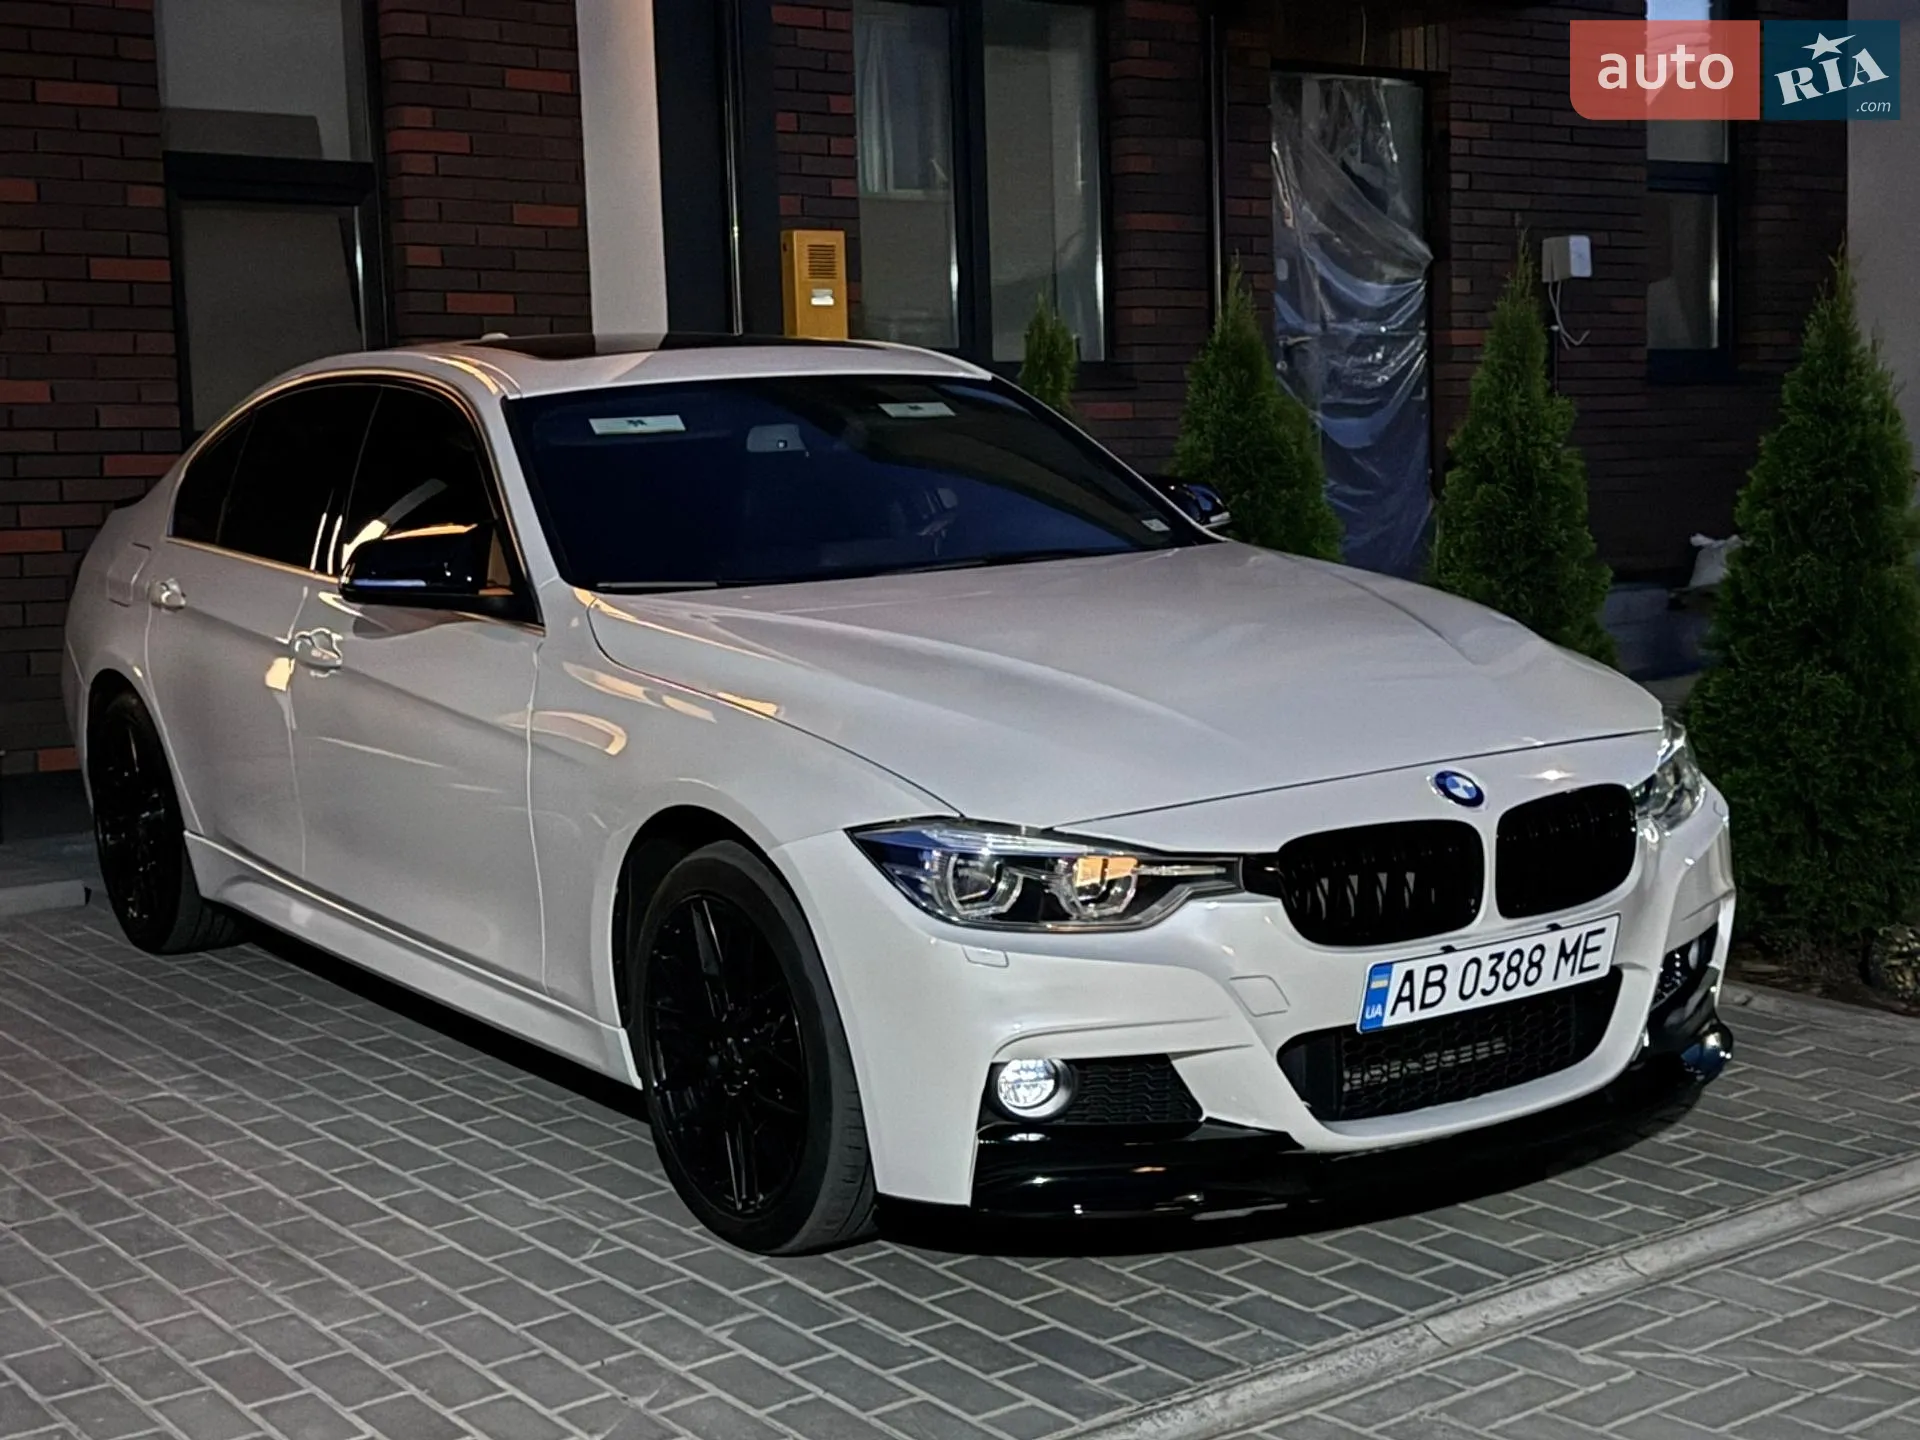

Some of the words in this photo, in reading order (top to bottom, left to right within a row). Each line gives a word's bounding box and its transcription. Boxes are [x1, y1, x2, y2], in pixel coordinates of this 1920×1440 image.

[1390, 963, 1448, 1017] AB
[1458, 943, 1546, 1001] 0388
[1553, 927, 1606, 981] ME
[1365, 1003, 1383, 1020] UA
